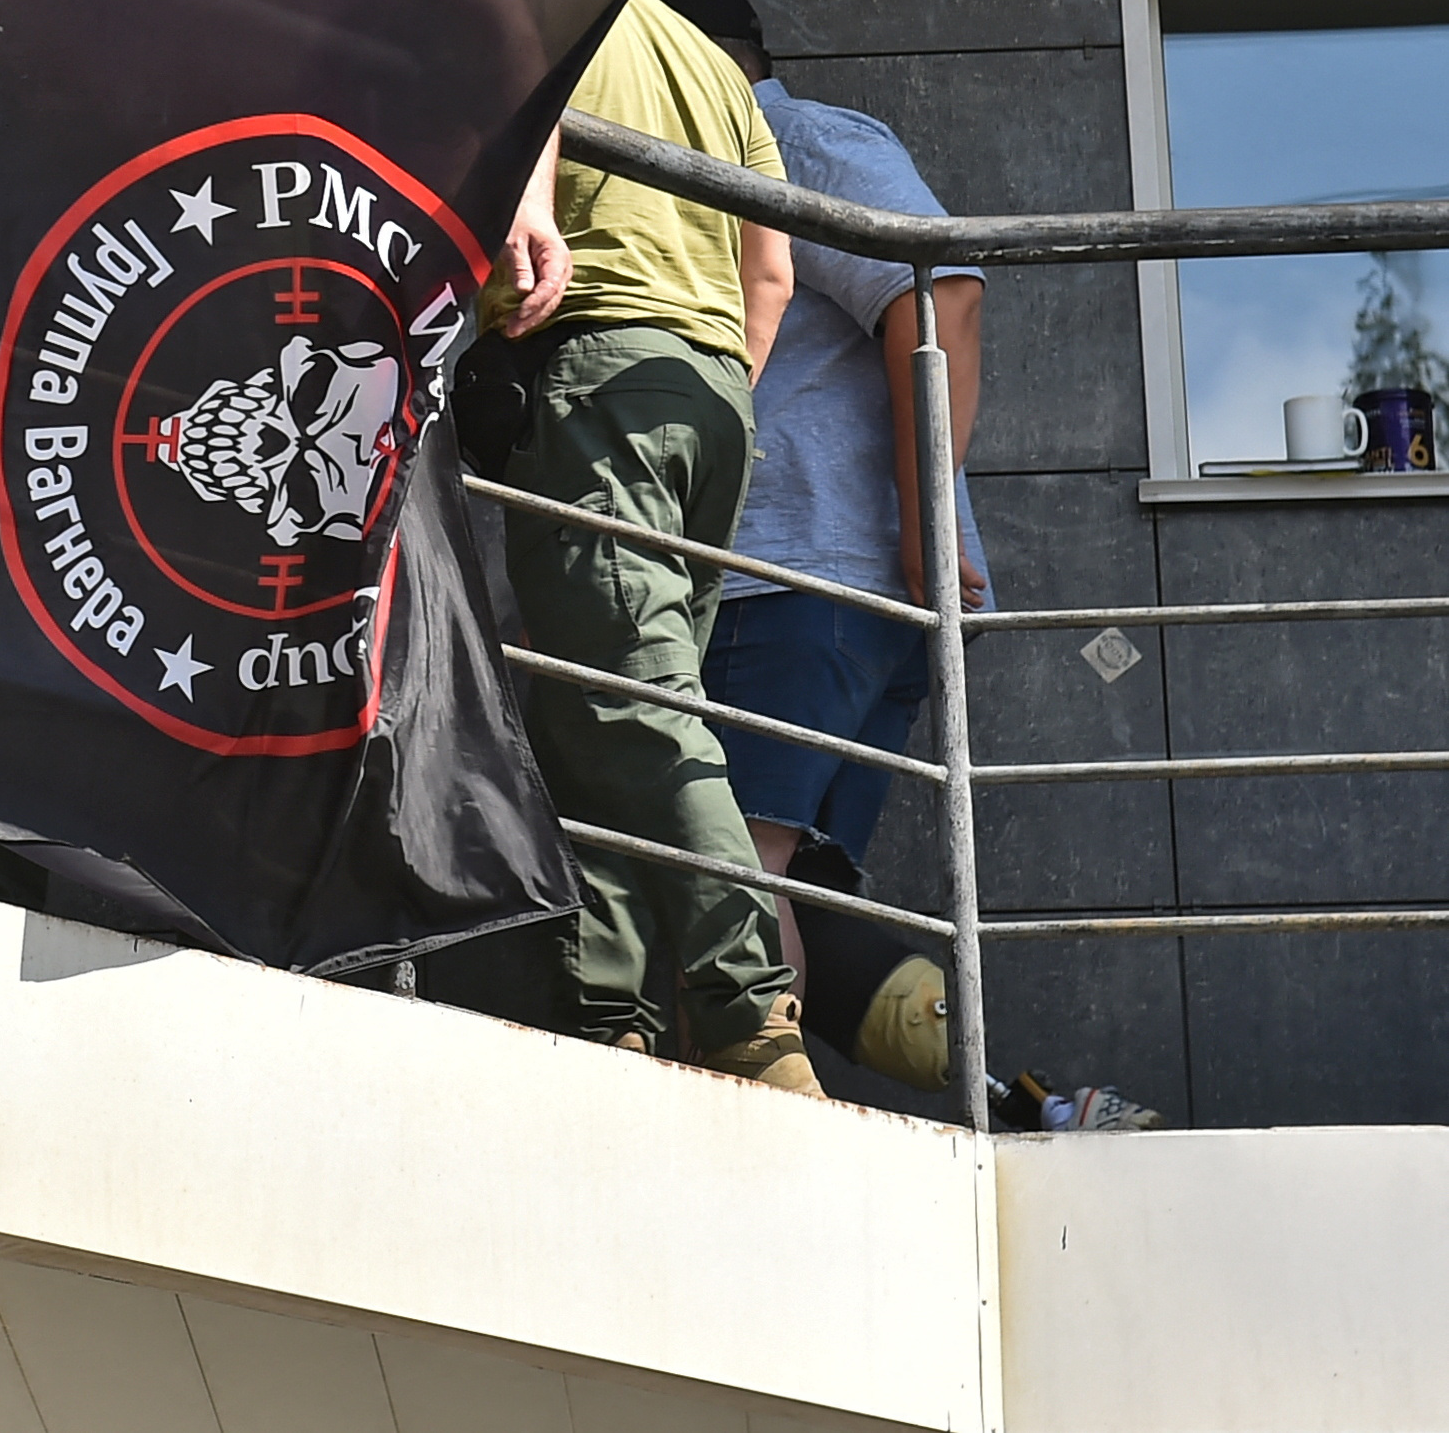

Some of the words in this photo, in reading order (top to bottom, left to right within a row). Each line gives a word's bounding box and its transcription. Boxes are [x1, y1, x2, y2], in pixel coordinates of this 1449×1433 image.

[251, 161, 421, 283] PMC
[29, 218, 175, 406] Группа
[1407, 433, 1430, 468] 6
[24, 424, 146, 658] Вагнера
